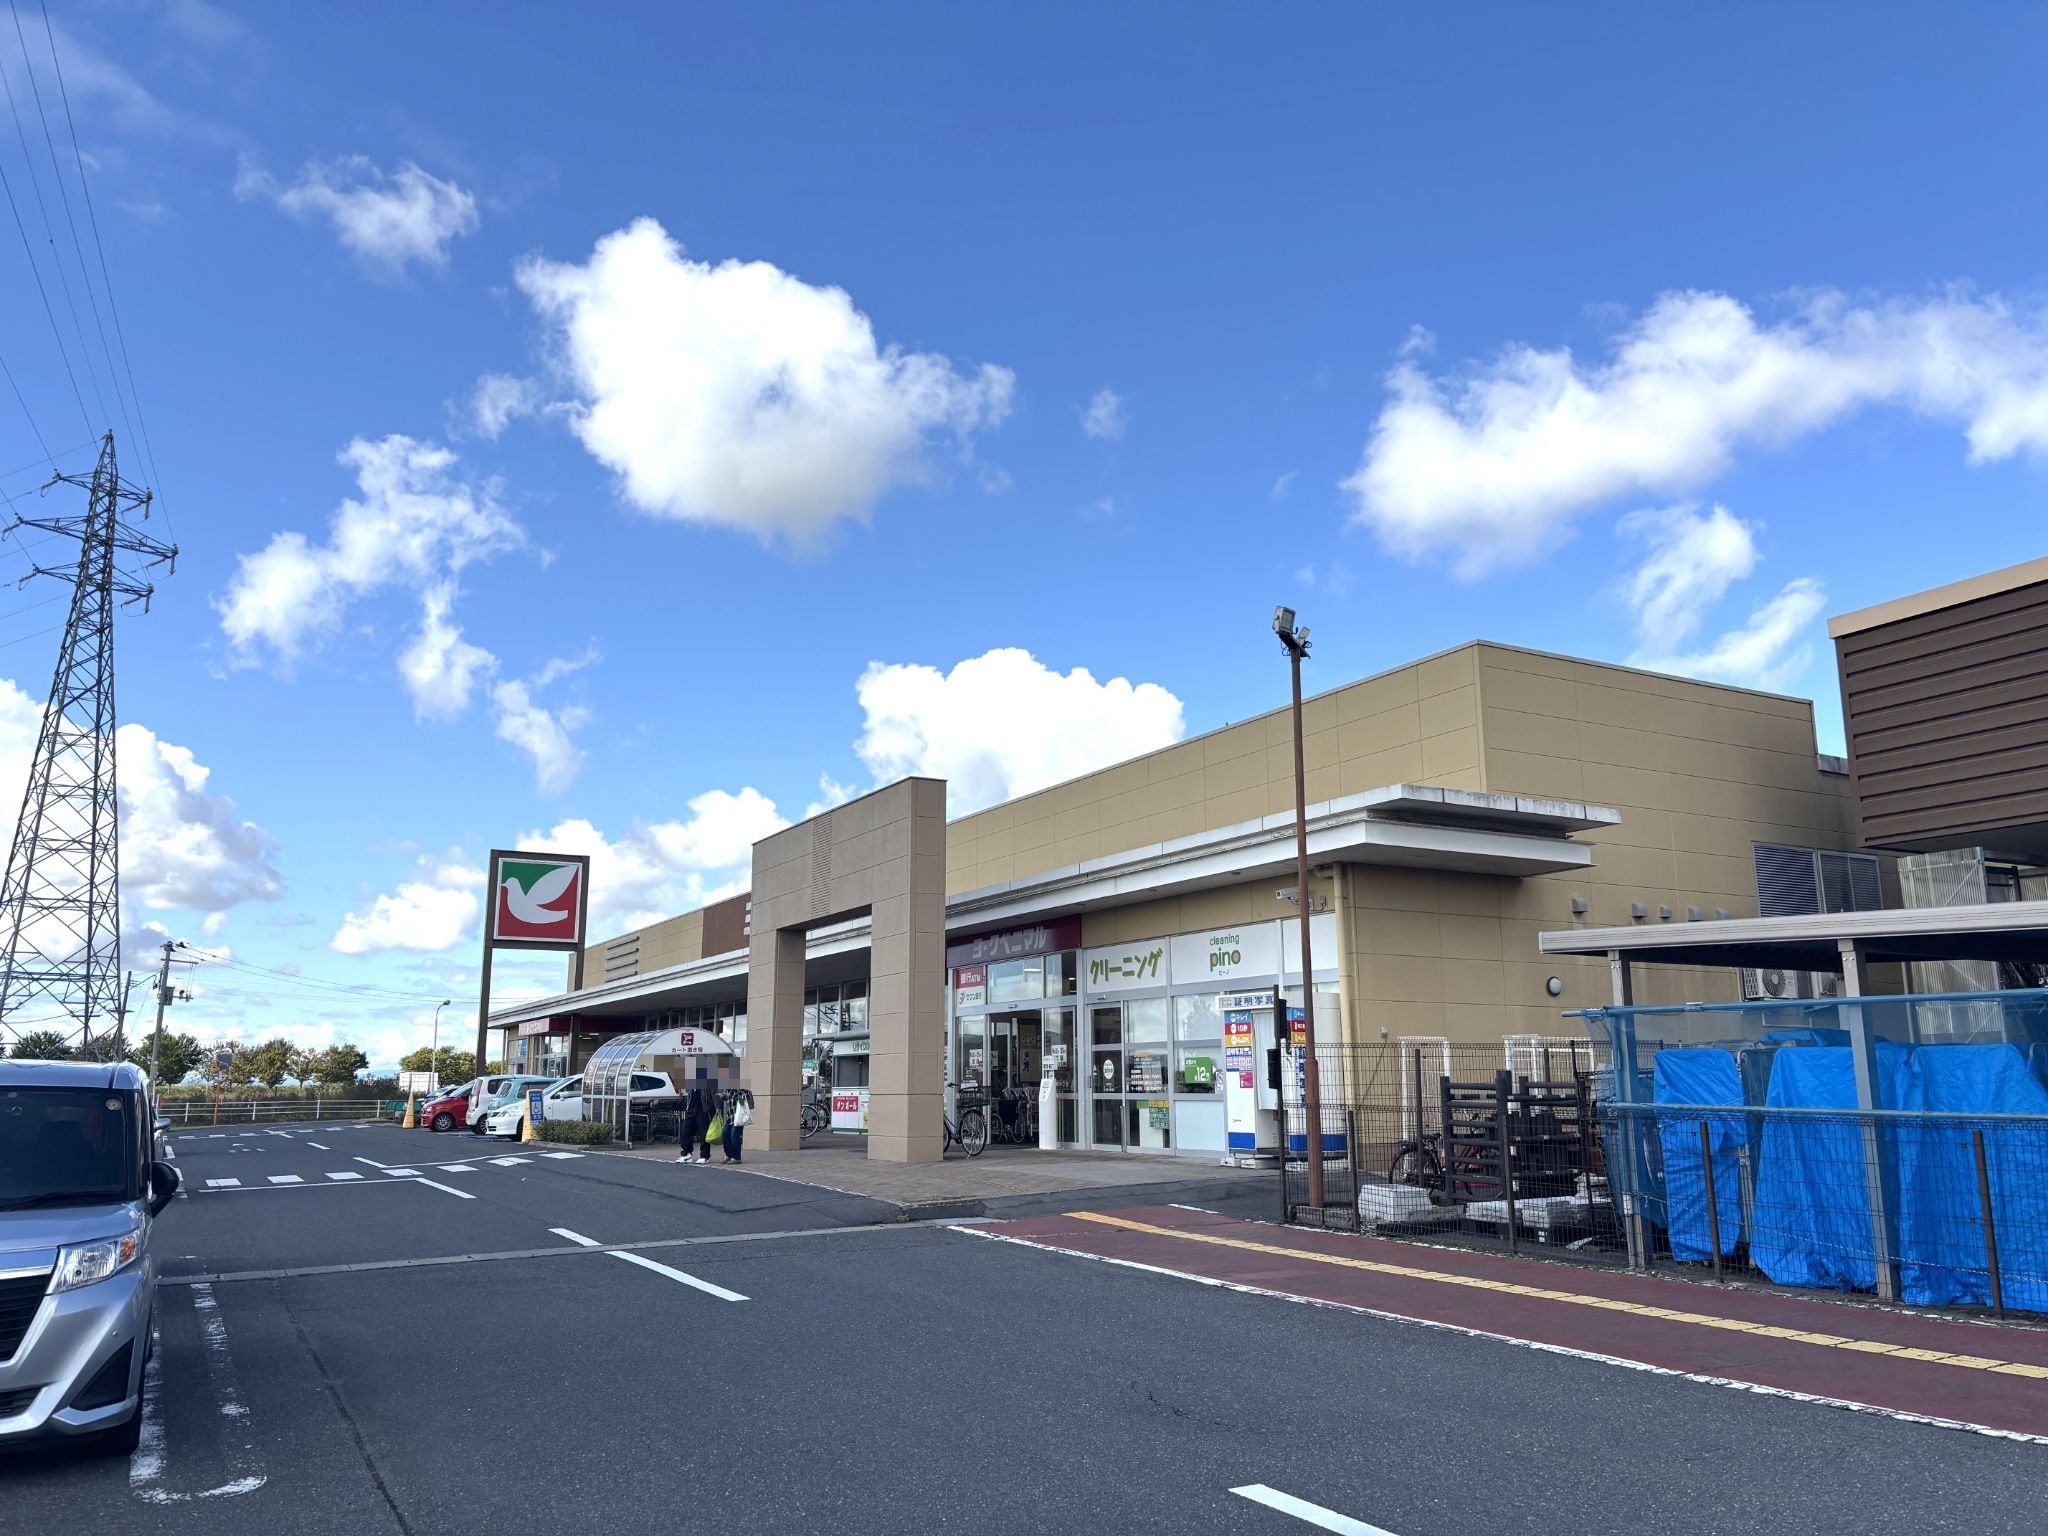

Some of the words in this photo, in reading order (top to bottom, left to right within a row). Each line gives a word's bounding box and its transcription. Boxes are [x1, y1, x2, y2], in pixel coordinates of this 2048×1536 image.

[1209, 934, 1240, 946] cleaning
[1090, 947, 1164, 985] クリーニング
[1209, 947, 1241, 972] pino
